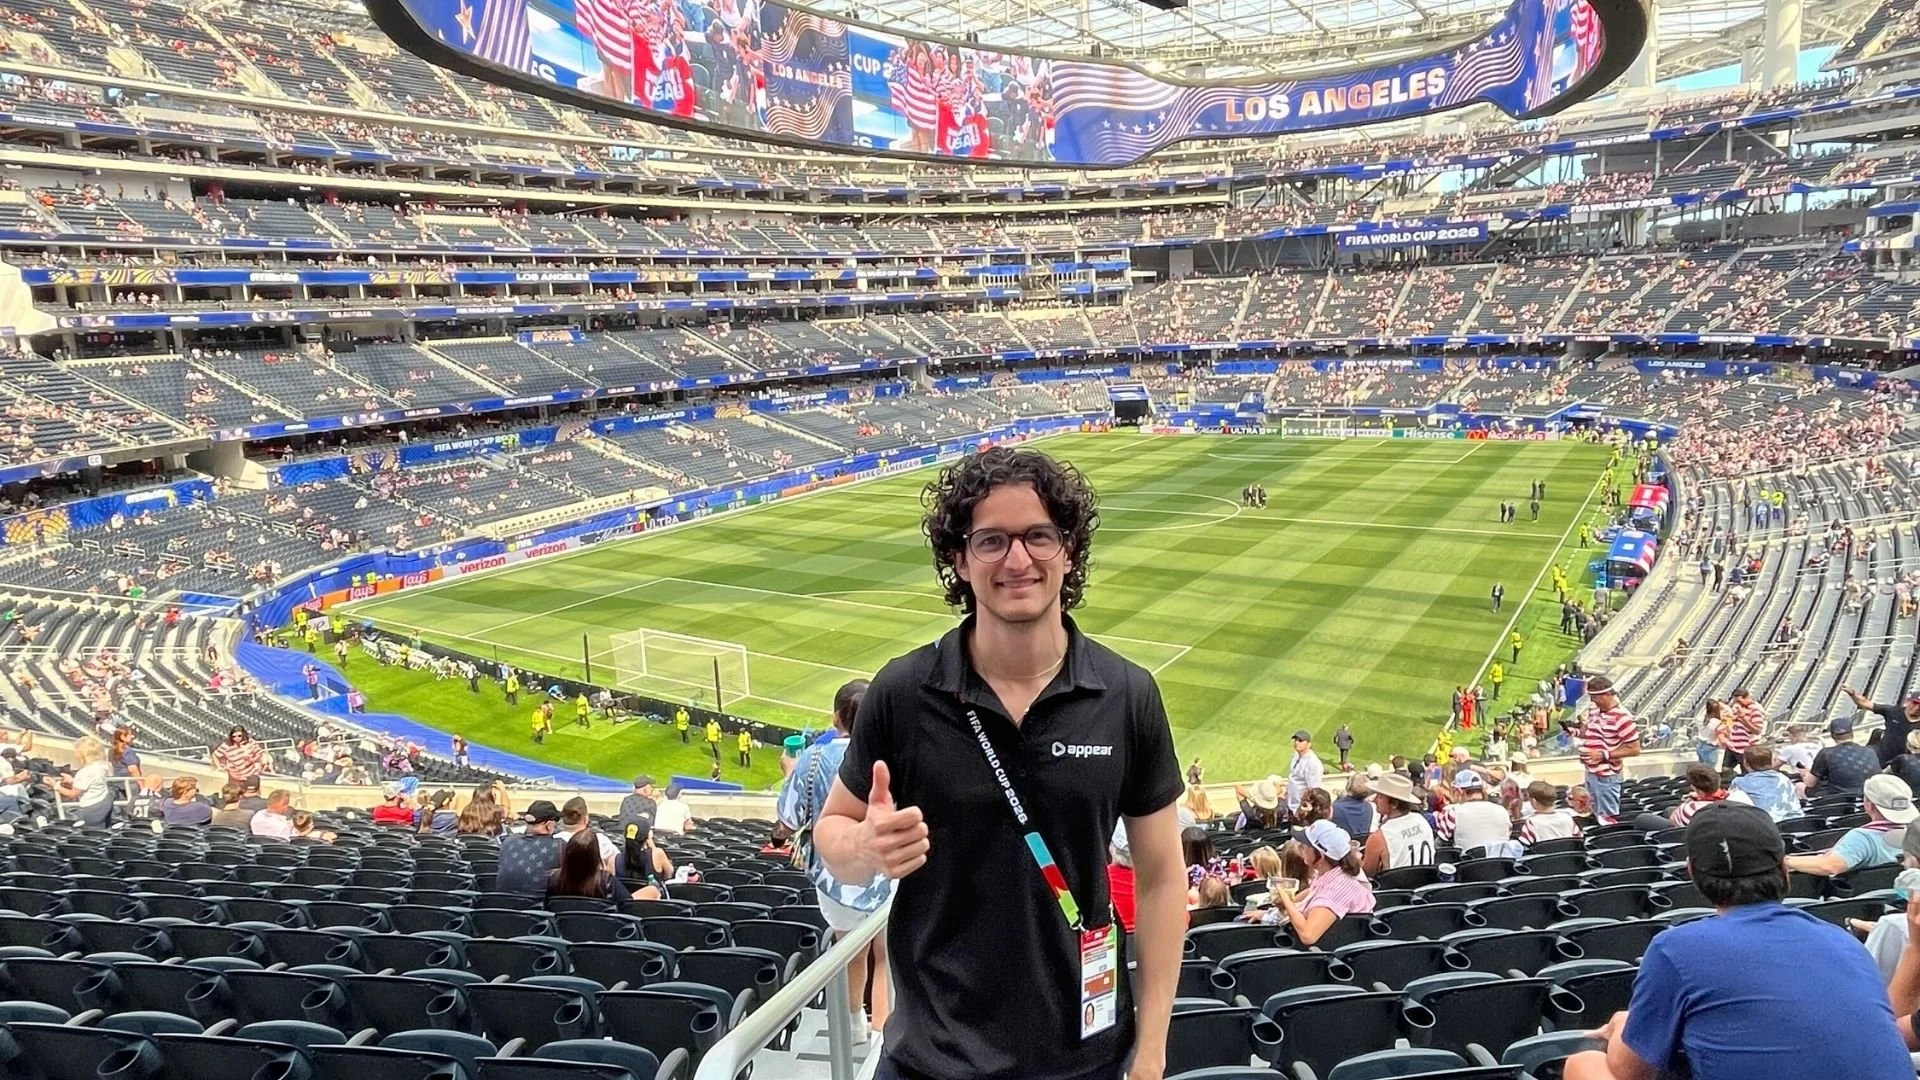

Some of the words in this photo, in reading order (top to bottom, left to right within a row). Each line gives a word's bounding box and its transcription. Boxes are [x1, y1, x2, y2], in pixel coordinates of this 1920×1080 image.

[853, 54, 881, 75] CUP
[772, 62, 793, 79] LOS
[795, 68, 843, 88] ANGELES
[1226, 94, 1290, 122] LOS
[1298, 67, 1446, 117] ANGELES
[1382, 169, 1405, 178] LOS
[1407, 164, 1464, 176] ANGELES
[1345, 234, 1370, 246] FIFA
[1371, 231, 1412, 244] WORLD
[1413, 229, 1436, 242] CUP
[1437, 227, 1480, 240] 2026
[516, 273, 539, 281] LOS
[540, 273, 590, 281] ANGELES
[1666, 361, 1706, 369] ANGELES
[634, 415, 650, 423] LOS
[651, 411, 686, 421] ANGELES
[1230, 427, 1259, 435] ULTRA
[1403, 429, 1456, 439] Hisense
[433, 442, 452, 452] FIFA
[644, 515, 680, 531] ULTRA
[525, 543, 568, 559] verizon
[460, 556, 507, 574] verizon
[1067, 744, 1113, 759] appear
[966, 709, 982, 734] FIFA
[977, 731, 1002, 769] WORLD
[994, 768, 1011, 789] CUP
[1004, 787, 1029, 825] 2026
[1407, 840, 1433, 866] 10
